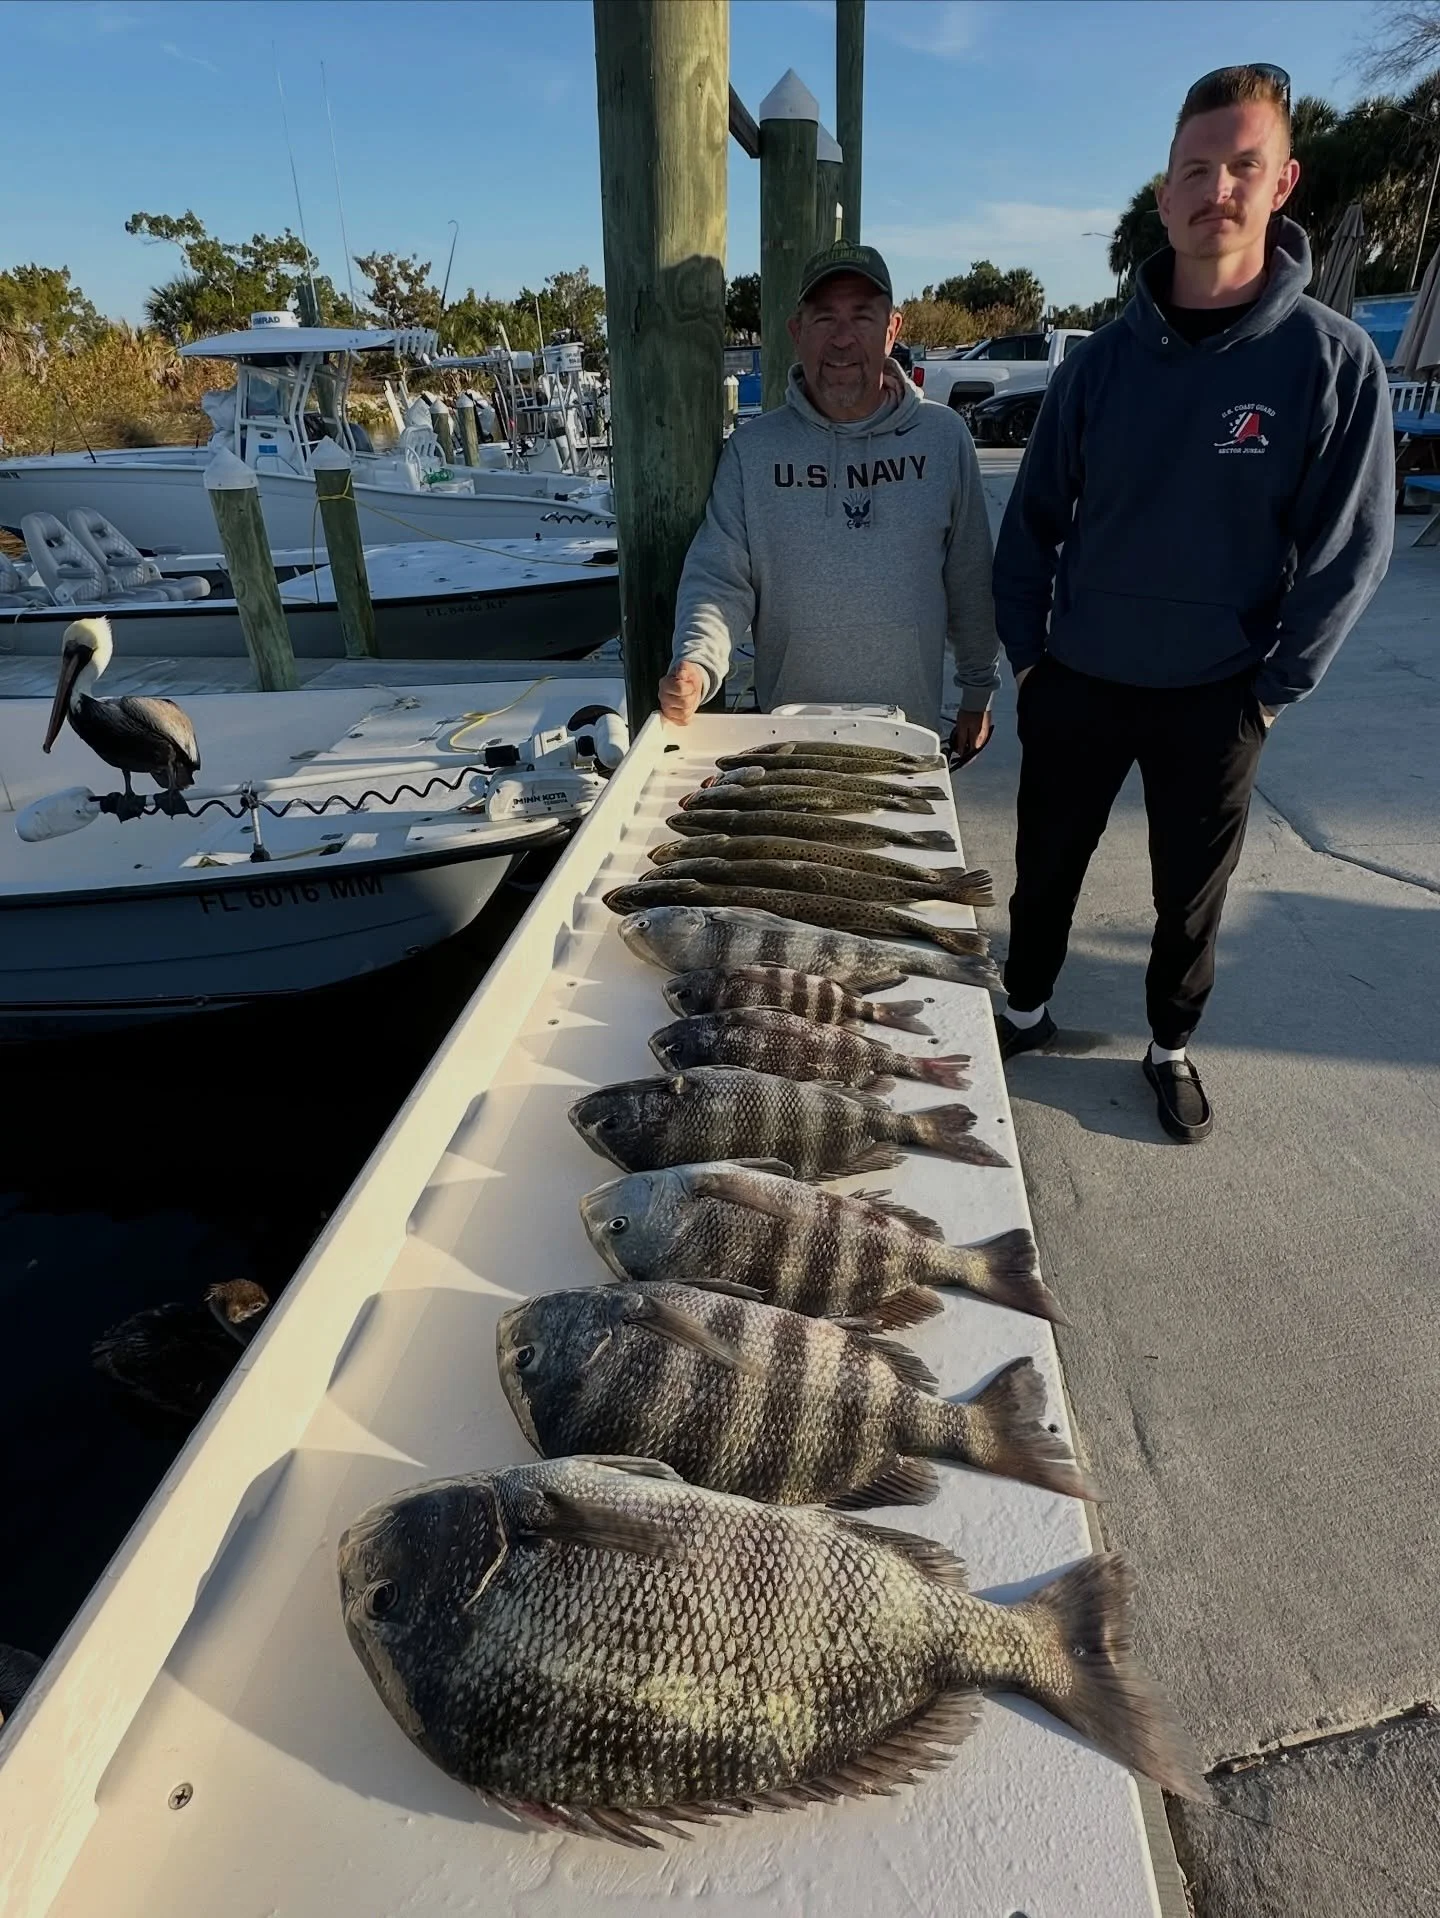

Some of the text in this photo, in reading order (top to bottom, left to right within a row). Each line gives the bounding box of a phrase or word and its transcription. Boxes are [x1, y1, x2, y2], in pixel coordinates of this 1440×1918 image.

[1234, 403, 1255, 412] COAST
[1255, 404, 1276, 417] GUARD
[846, 455, 926, 489] NAVY
[513, 791, 567, 805] MINN KOTA
[198, 874, 384, 914] FL 6016 MM
